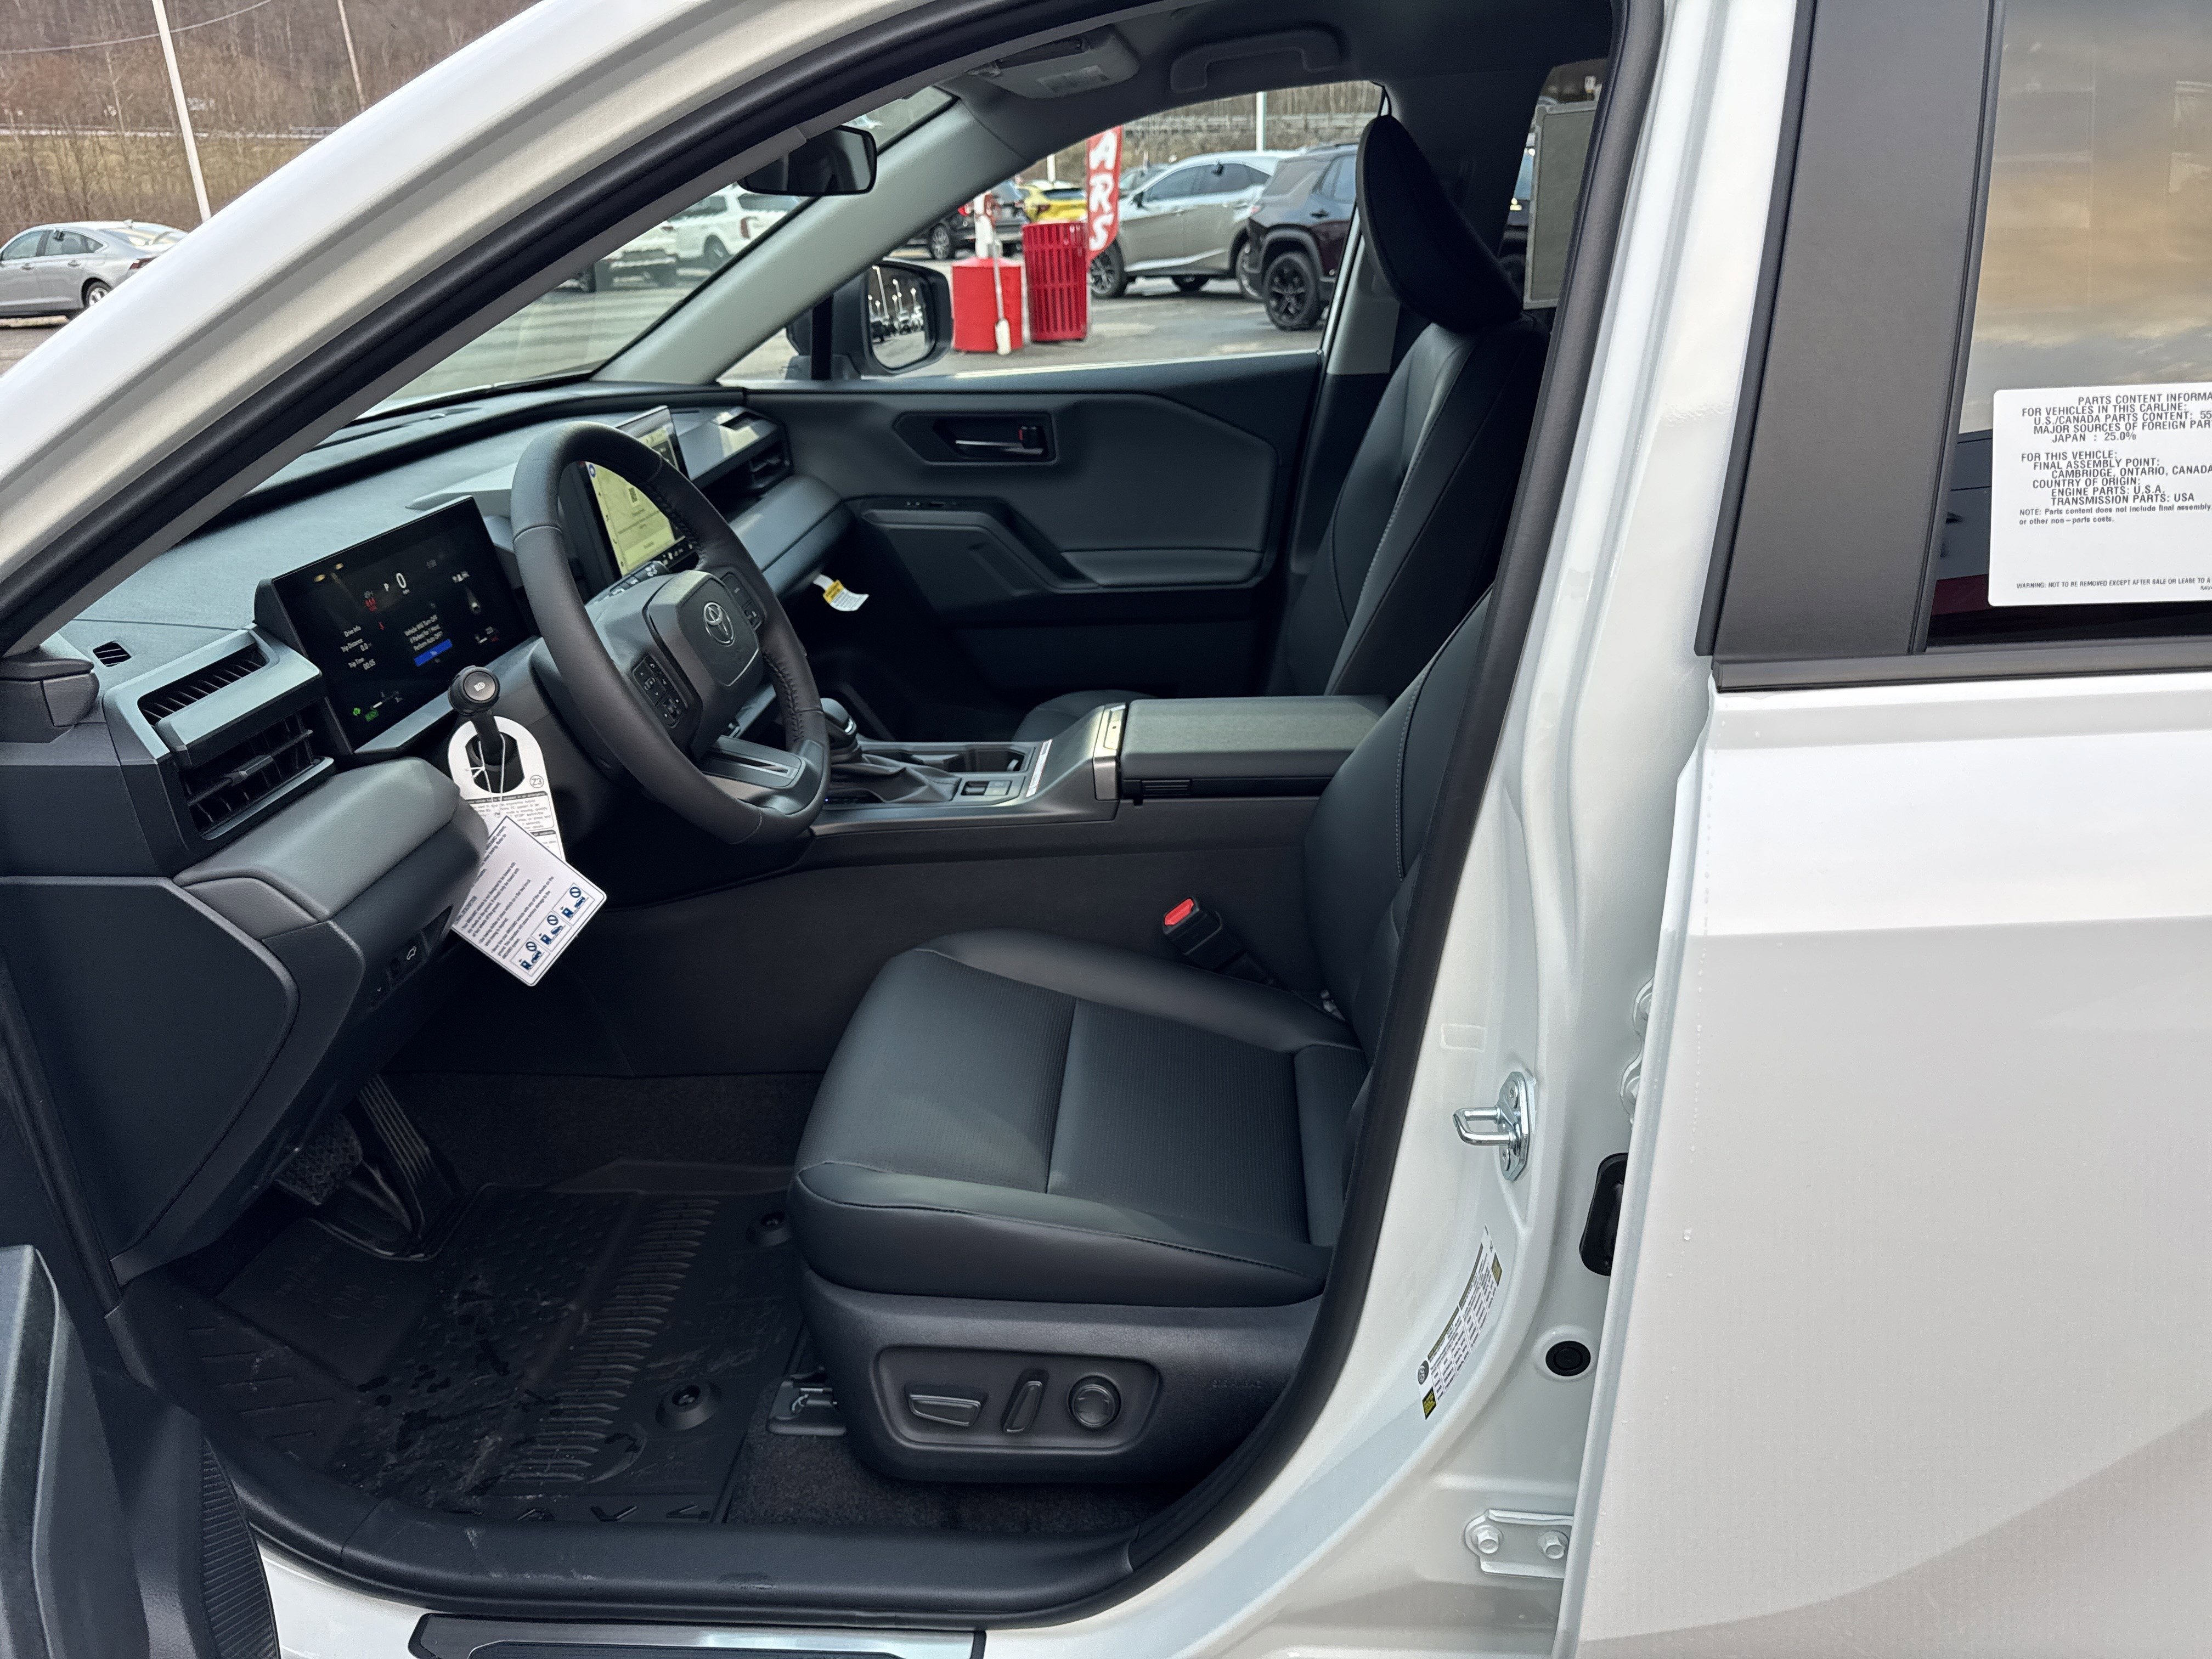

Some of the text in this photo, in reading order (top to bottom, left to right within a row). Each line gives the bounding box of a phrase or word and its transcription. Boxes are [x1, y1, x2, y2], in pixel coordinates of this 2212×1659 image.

[2078, 396, 2111, 405] PARTS
[2115, 393, 2163, 404] CONTENT
[2022, 402, 2187, 417] FOR VEHICLES IN THIS CARLINE:
[2034, 414, 2101, 425] U.S./CANADA
[2105, 413, 2138, 423] PARTS
[2142, 411, 2193, 421] CONTENT:
[2034, 419, 2212, 435] MAJOR SOURCES OF FOREIGN PAR
[2052, 433, 2085, 443] JAPAN
[2104, 431, 2136, 441] 25.0%
[2021, 450, 2117, 462] FOR THIS VEHICLE:
[2033, 458, 2159, 470] FINAL ASSEMBLY POINT:
[2051, 465, 2212, 479] CAMBRIDGE, ONTARIO, CANADA
[2033, 476, 2140, 489] COUNTRY OF ORIGIN:
[2051, 484, 2165, 497] ENGINE PARTS: U.S.A.
[2051, 493, 2194, 506] TRANSMISSION PARTS: USA
[396, 573, 407, 589] 0
